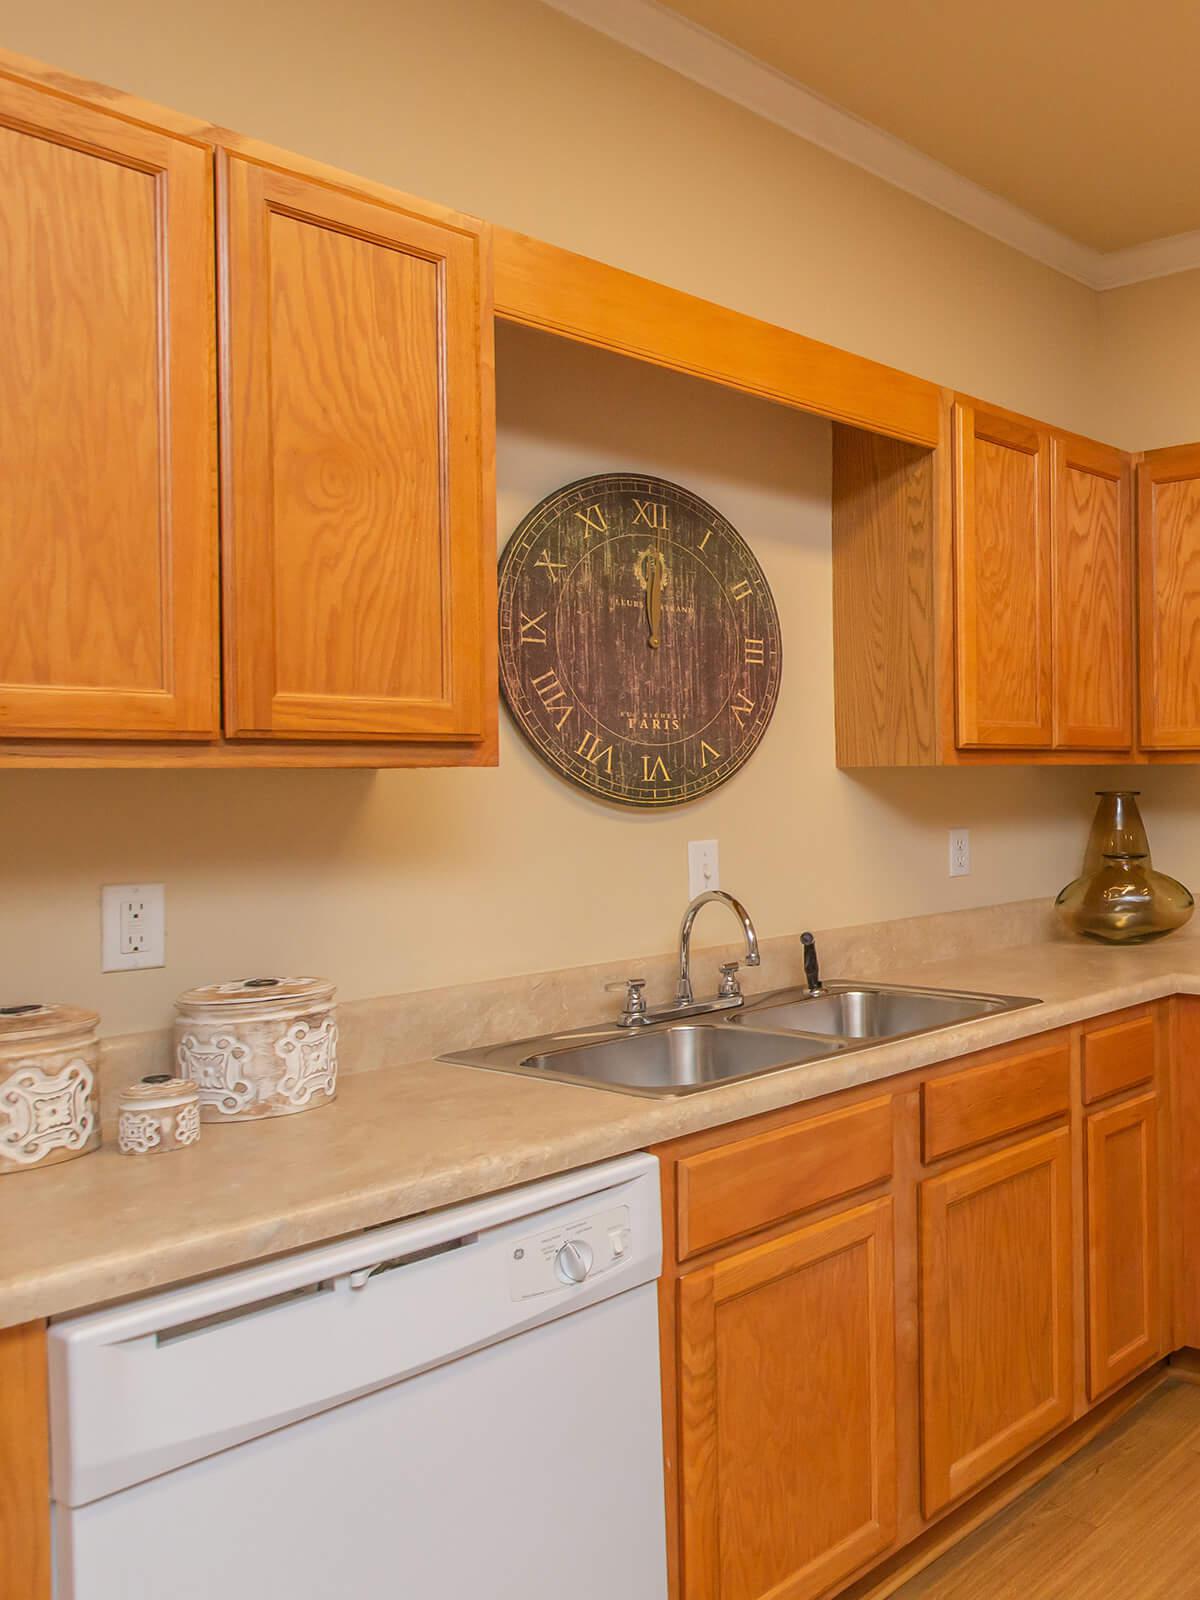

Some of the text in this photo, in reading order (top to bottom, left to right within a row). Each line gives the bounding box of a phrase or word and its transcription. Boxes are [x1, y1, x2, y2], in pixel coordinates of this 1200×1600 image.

[575, 504, 608, 539] XI
[632, 499, 669, 530] XII
[698, 529, 714, 552] I
[534, 549, 567, 583] X
[730, 579, 754, 601] II
[521, 610, 547, 647] IX
[745, 638, 764, 666] III
[531, 667, 574, 731] VIII
[731, 691, 757, 728] IV
[628, 718, 680, 730] PARIS
[576, 730, 613, 774] VII
[700, 740, 721, 769] V
[641, 755, 672, 782] VI
